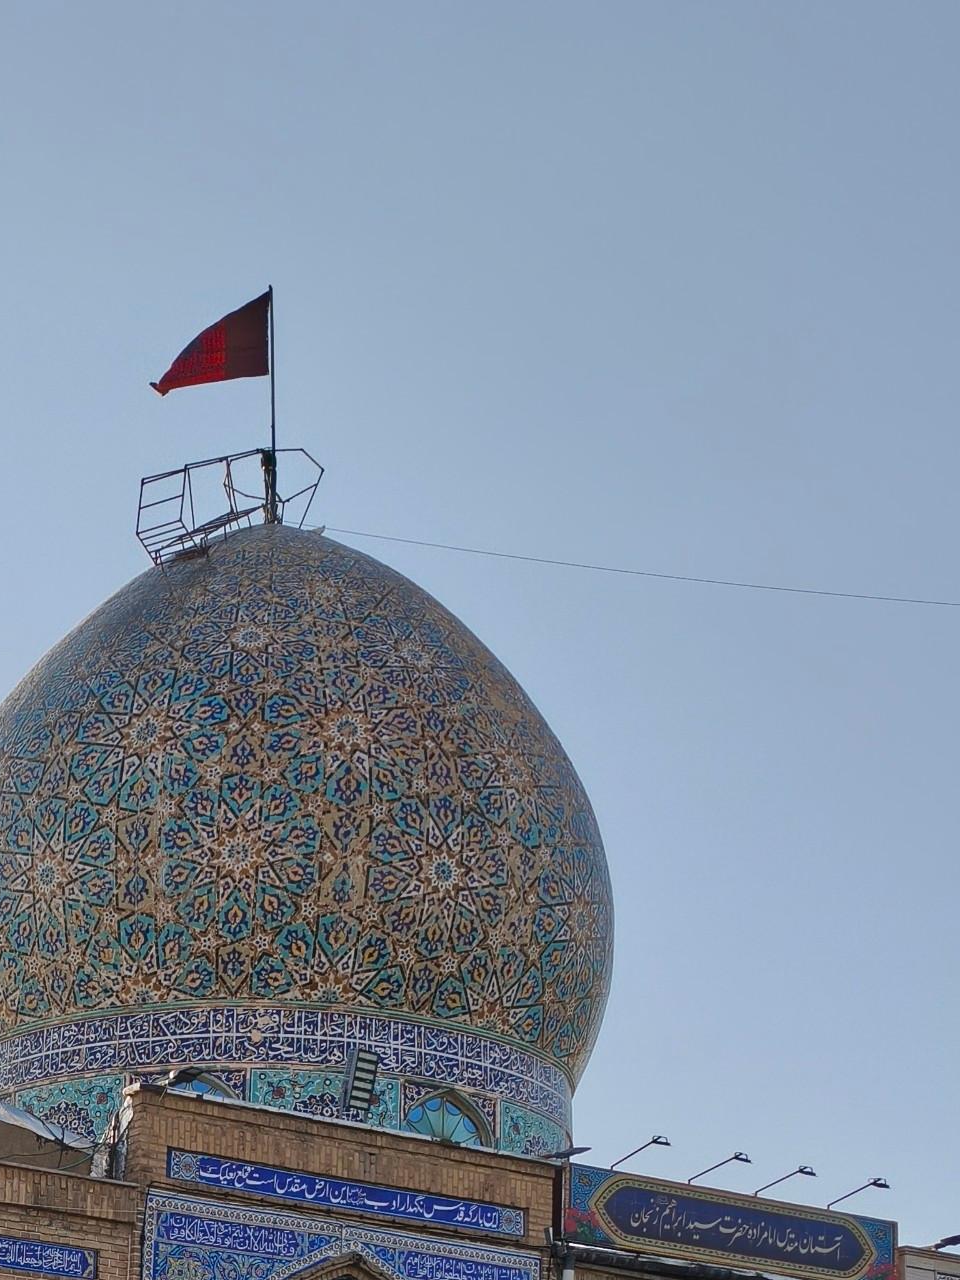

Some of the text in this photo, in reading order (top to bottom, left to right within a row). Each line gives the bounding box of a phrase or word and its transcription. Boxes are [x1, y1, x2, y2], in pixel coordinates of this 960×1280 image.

[275, 1176, 306, 1194] مقدس
[630, 1198, 844, 1261] آستان مقدس امامزاده حضرت سید ابراهیم زنجان
